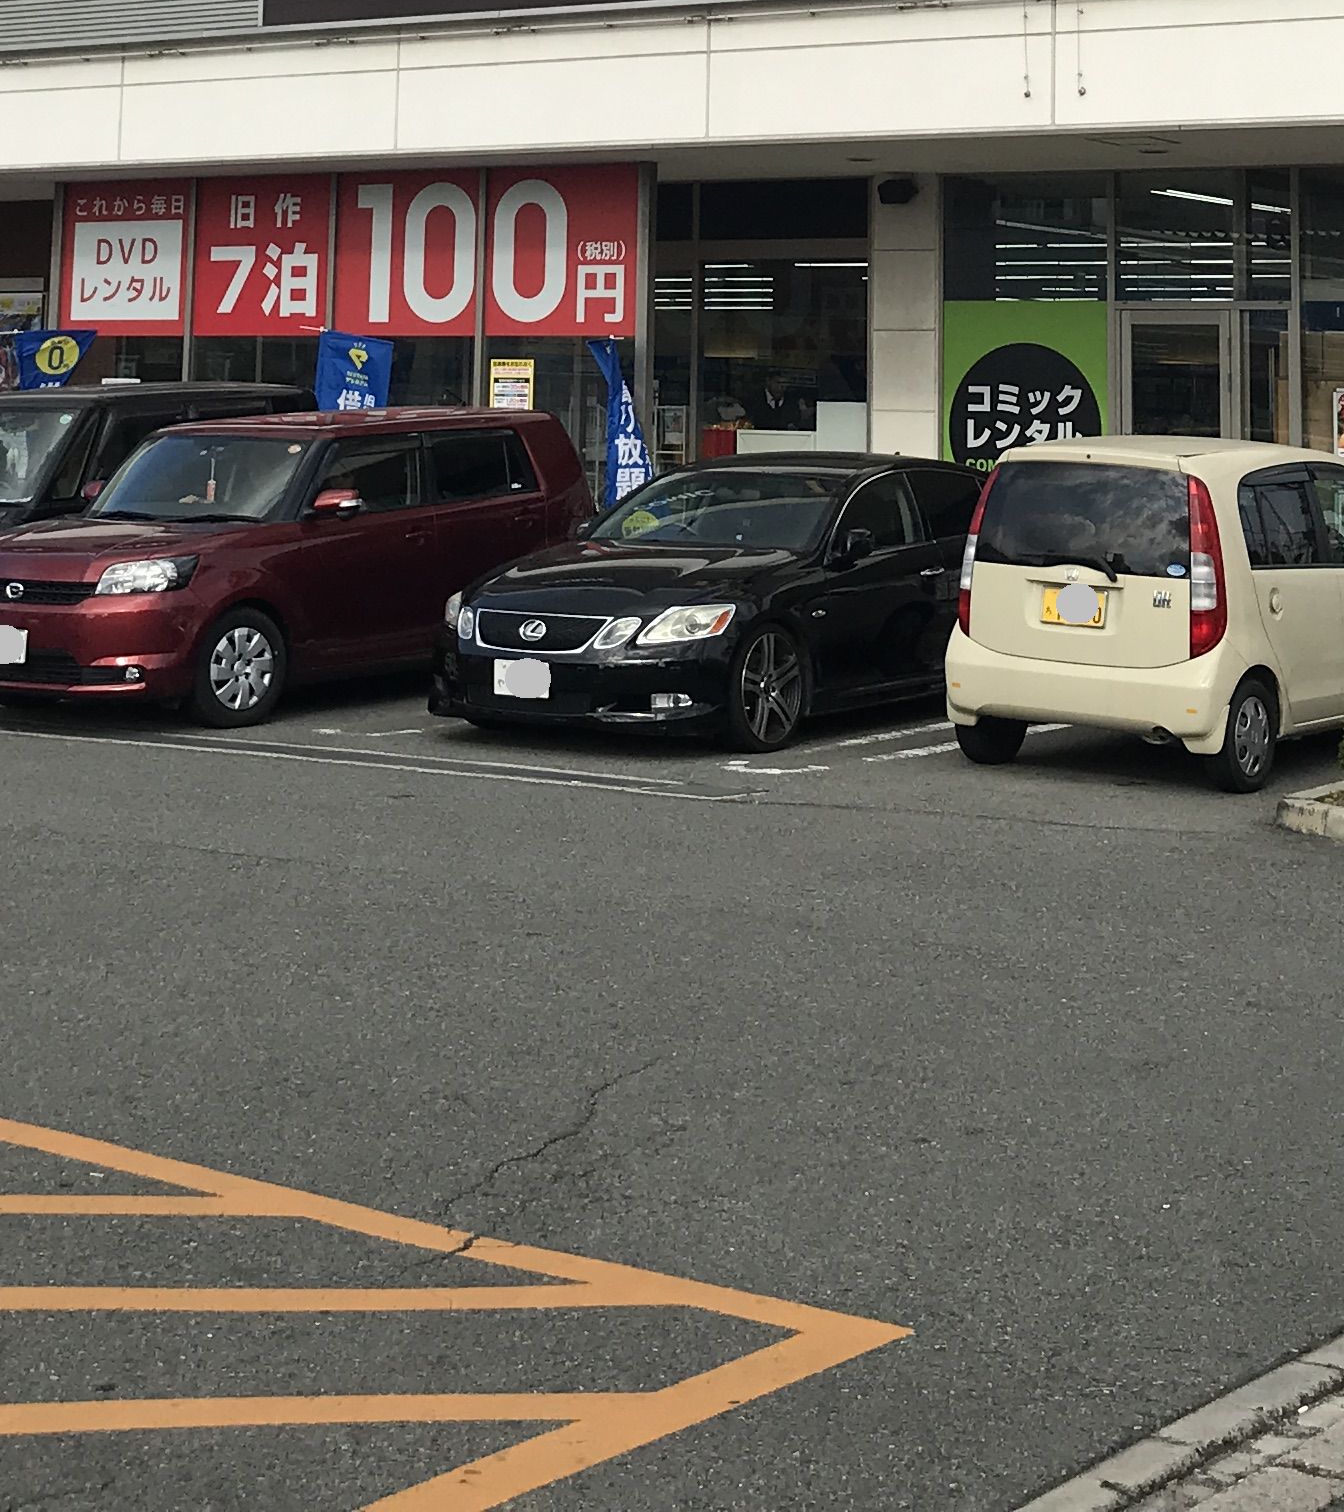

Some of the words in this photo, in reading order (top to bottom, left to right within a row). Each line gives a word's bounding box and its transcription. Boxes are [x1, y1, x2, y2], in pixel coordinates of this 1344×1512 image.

[74, 195, 185, 216] これから毎日
[96, 237, 158, 265] DVD
[80, 276, 171, 303] レンタル
[968, 384, 1083, 416] コミック
